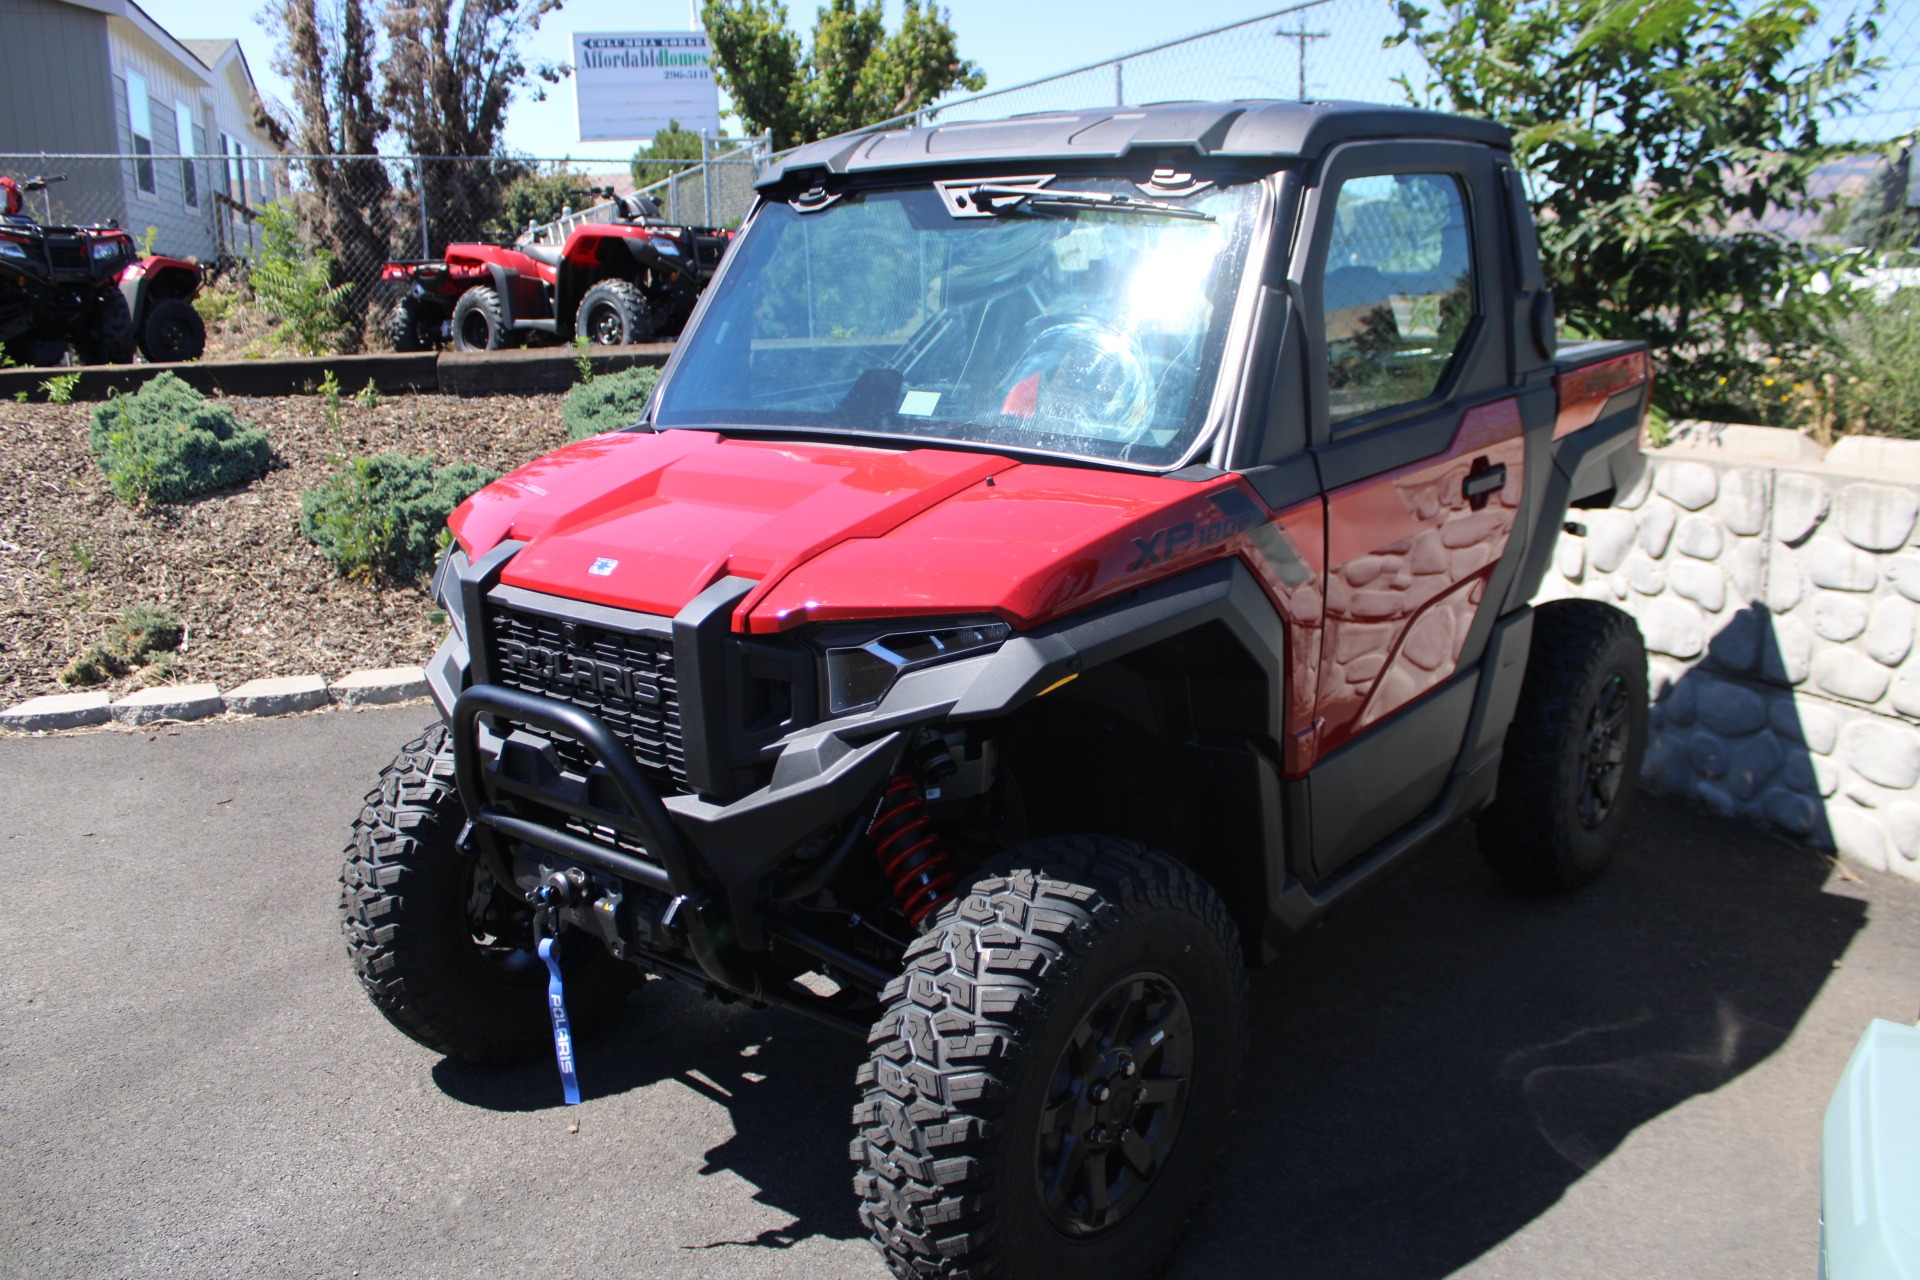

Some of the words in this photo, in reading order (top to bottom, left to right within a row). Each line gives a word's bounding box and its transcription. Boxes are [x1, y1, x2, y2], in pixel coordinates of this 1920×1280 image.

[589, 37, 656, 47] COLUMBIA
[660, 37, 704, 46] GORGE
[1131, 521, 1195, 572] XP
[505, 638, 662, 705] POLARIS
[550, 993, 573, 1074] POLARIS
